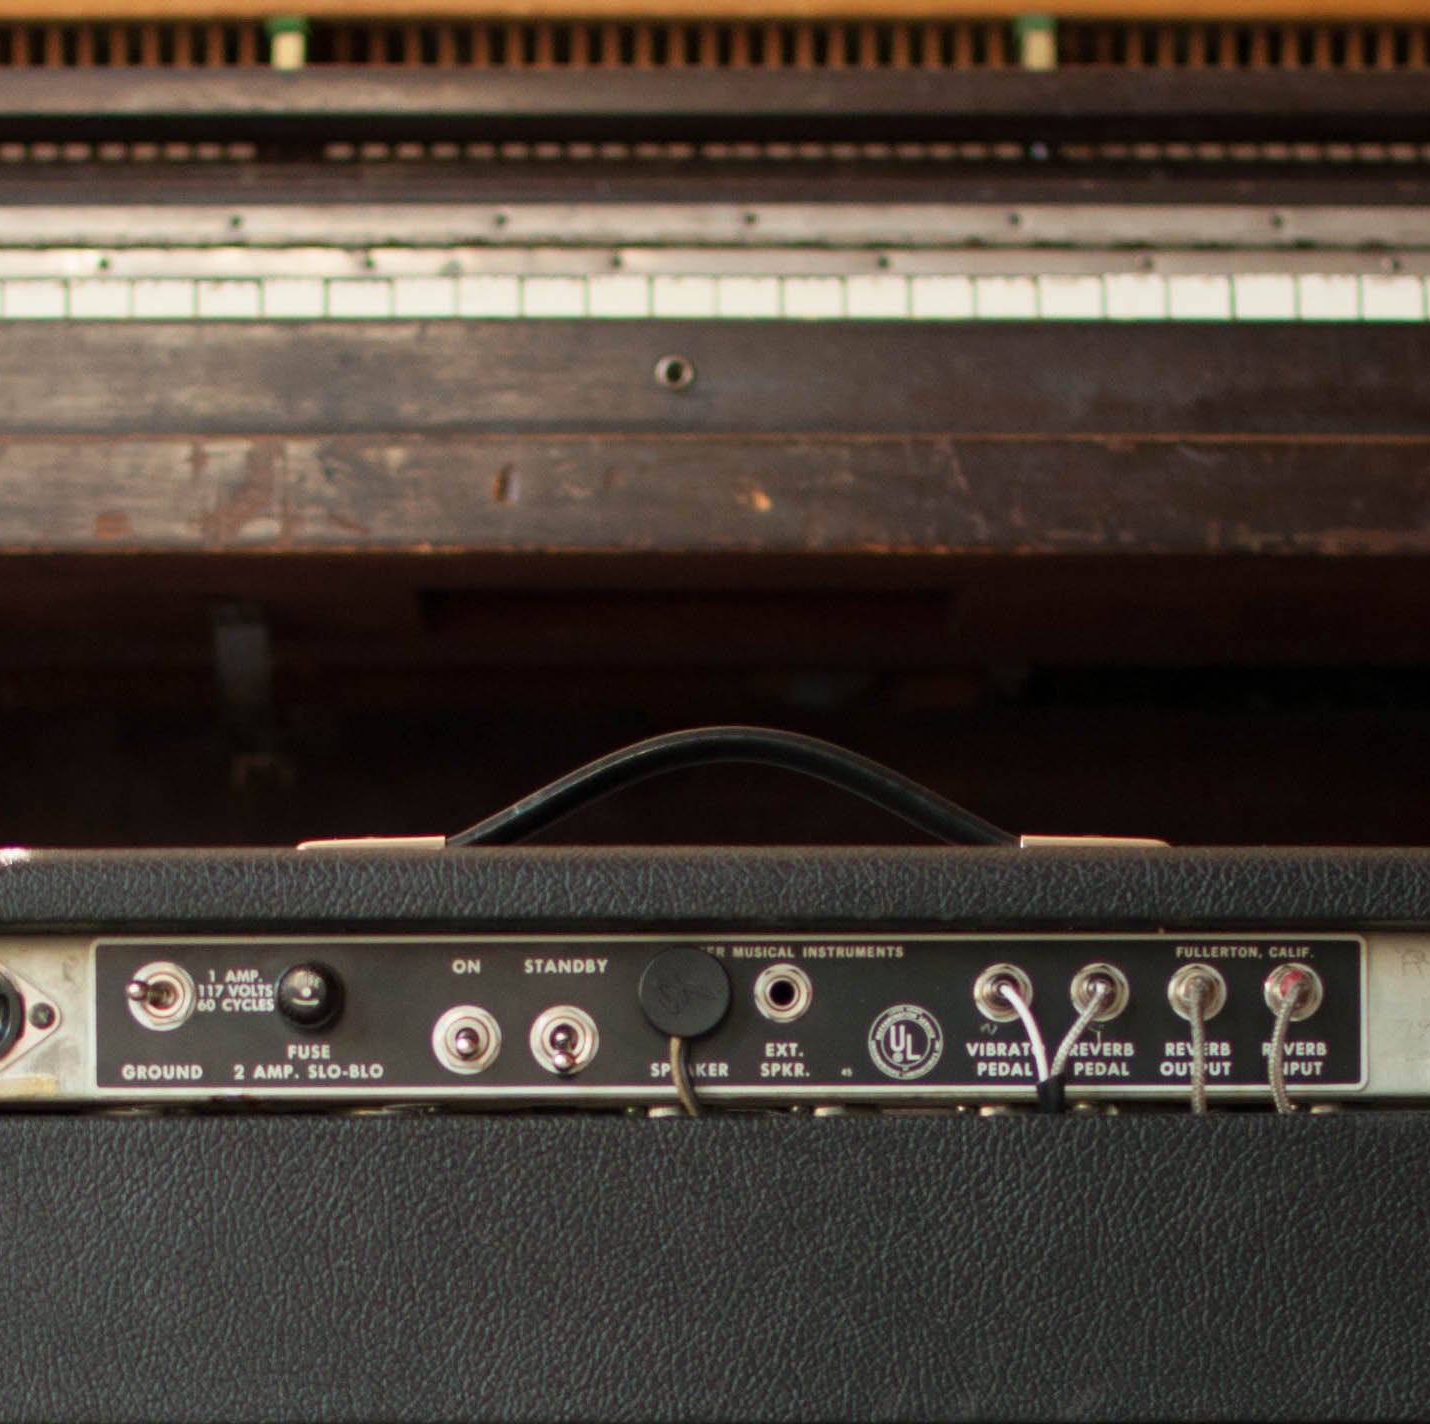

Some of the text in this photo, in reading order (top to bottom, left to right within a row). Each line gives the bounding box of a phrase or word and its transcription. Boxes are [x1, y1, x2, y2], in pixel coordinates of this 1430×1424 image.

[733, 946, 796, 959] MUSICAL
[802, 946, 904, 959] INSTRUMENTS
[1176, 946, 1314, 959] FULLERTON, CALIF.
[452, 959, 608, 974] ON STANDBY
[209, 969, 263, 983] 1 AMP.
[198, 984, 273, 998] 117 VOLTS
[197, 998, 275, 1012] 60 CYCLES
[287, 1045, 330, 1060] FUSE
[765, 1042, 804, 1057] EXT.
[966, 1042, 1041, 1057] VIBRAT
[1069, 1042, 1134, 1057] REVERB
[1262, 1042, 1327, 1057] RVERB
[122, 1065, 203, 1080] GROUND
[234, 1064, 384, 1080] 2 AMP. SLO-BLO
[650, 1062, 729, 1078] SPKER
[760, 1062, 810, 1077] SPKR.
[977, 1062, 1033, 1077] PEDAL
[1074, 1062, 1130, 1077] PEDAL
[1160, 1061, 1231, 1077] OUTUT
